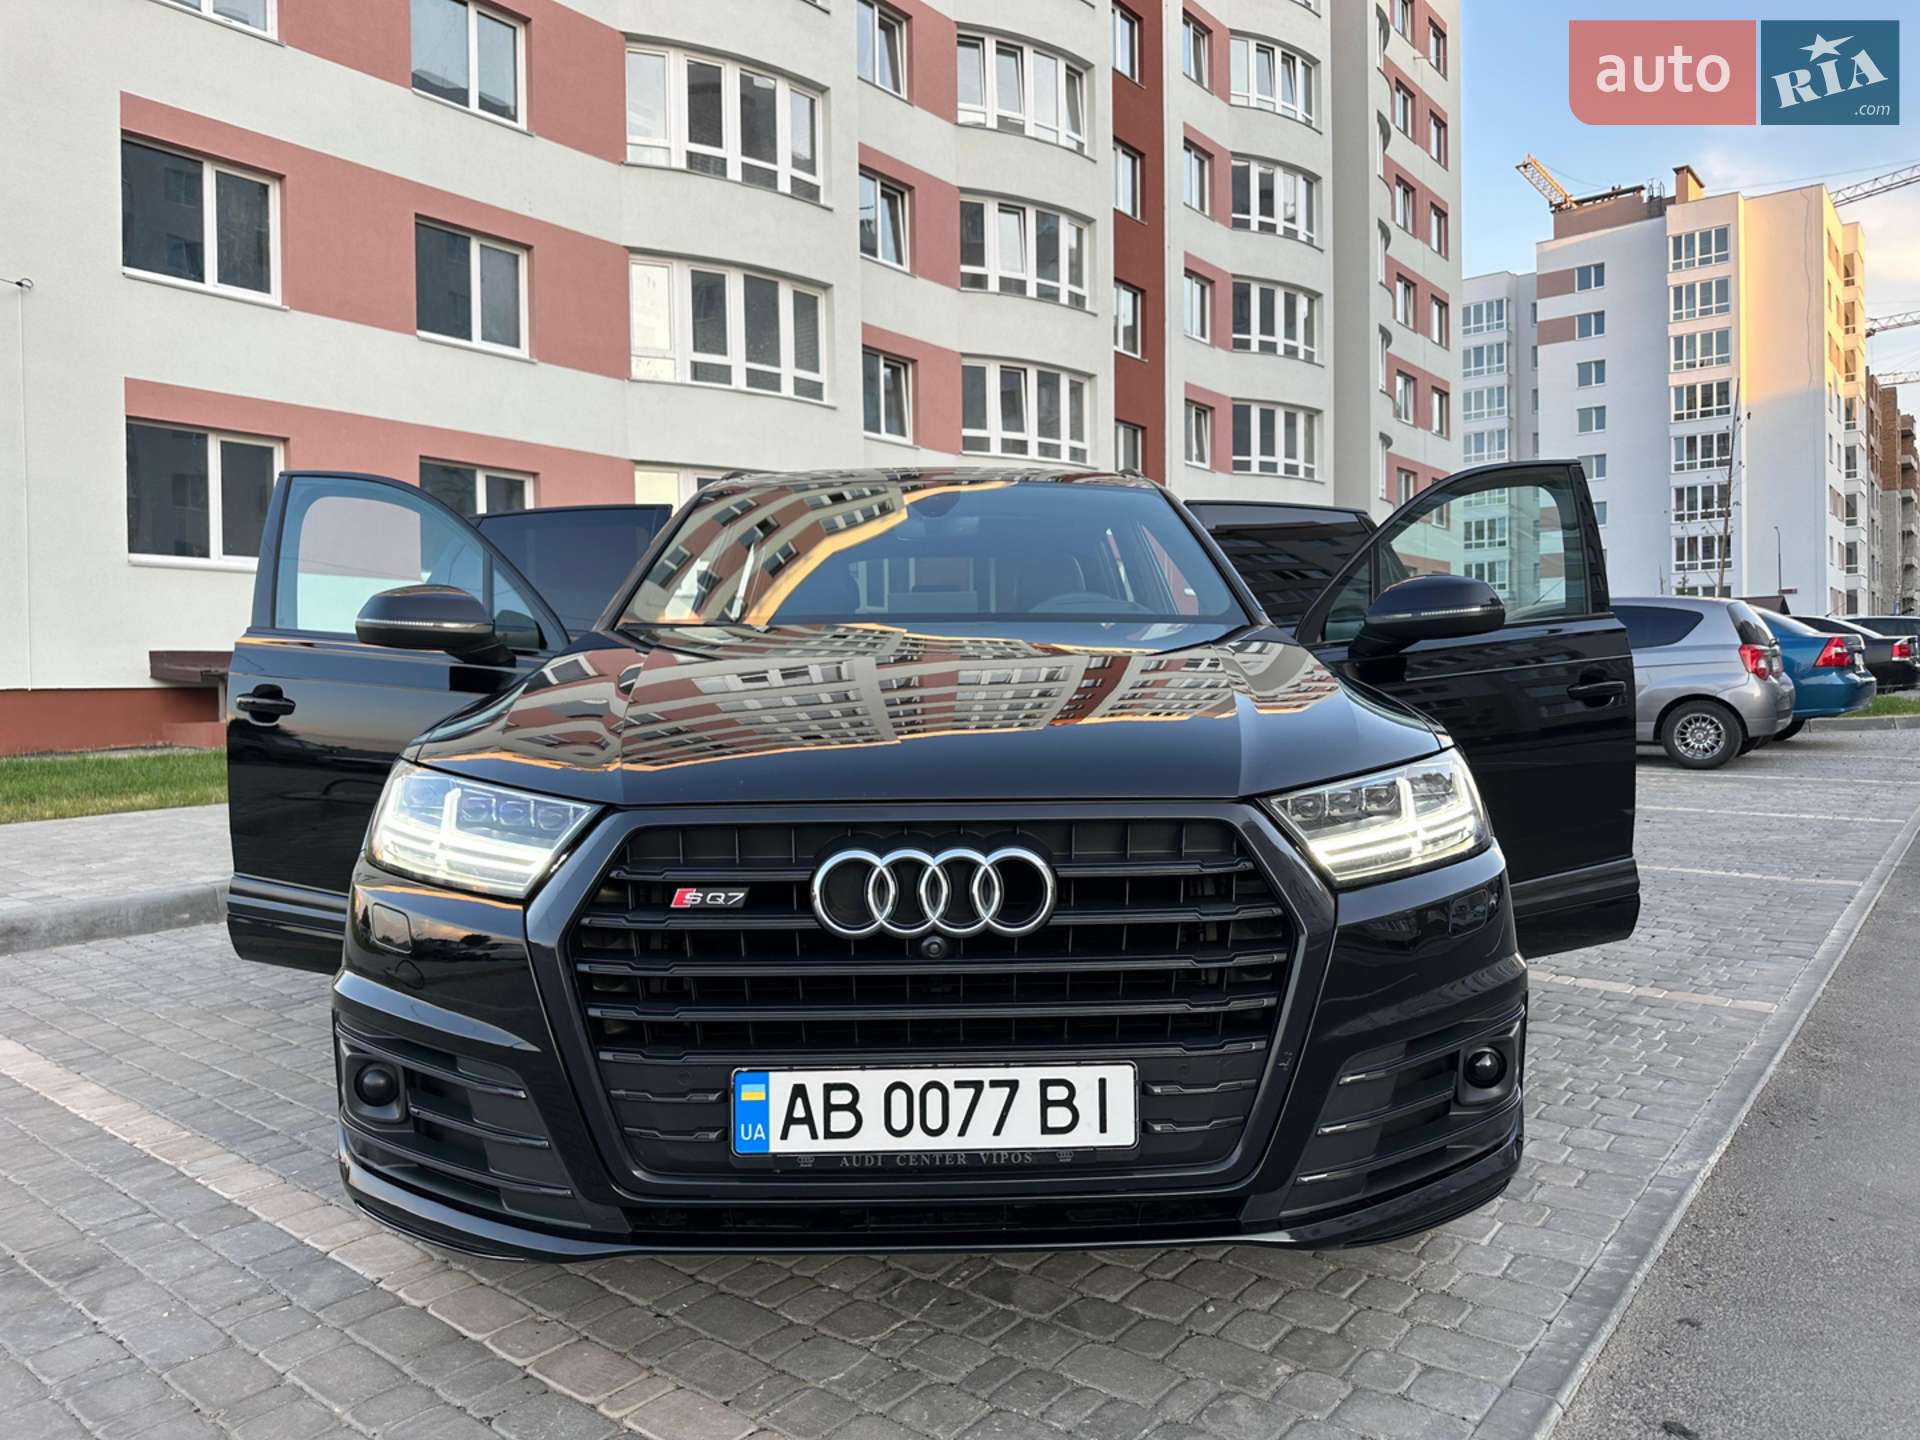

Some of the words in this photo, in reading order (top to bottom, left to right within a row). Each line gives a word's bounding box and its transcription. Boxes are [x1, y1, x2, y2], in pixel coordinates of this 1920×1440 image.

[681, 891, 746, 906] SQ7
[779, 1081, 864, 1141] AB
[883, 1079, 1020, 1139] 0077
[740, 1123, 766, 1141] UA
[839, 1154, 883, 1168] AUDI
[896, 1152, 968, 1167] CENTER
[980, 1151, 1033, 1165] VIPOS
